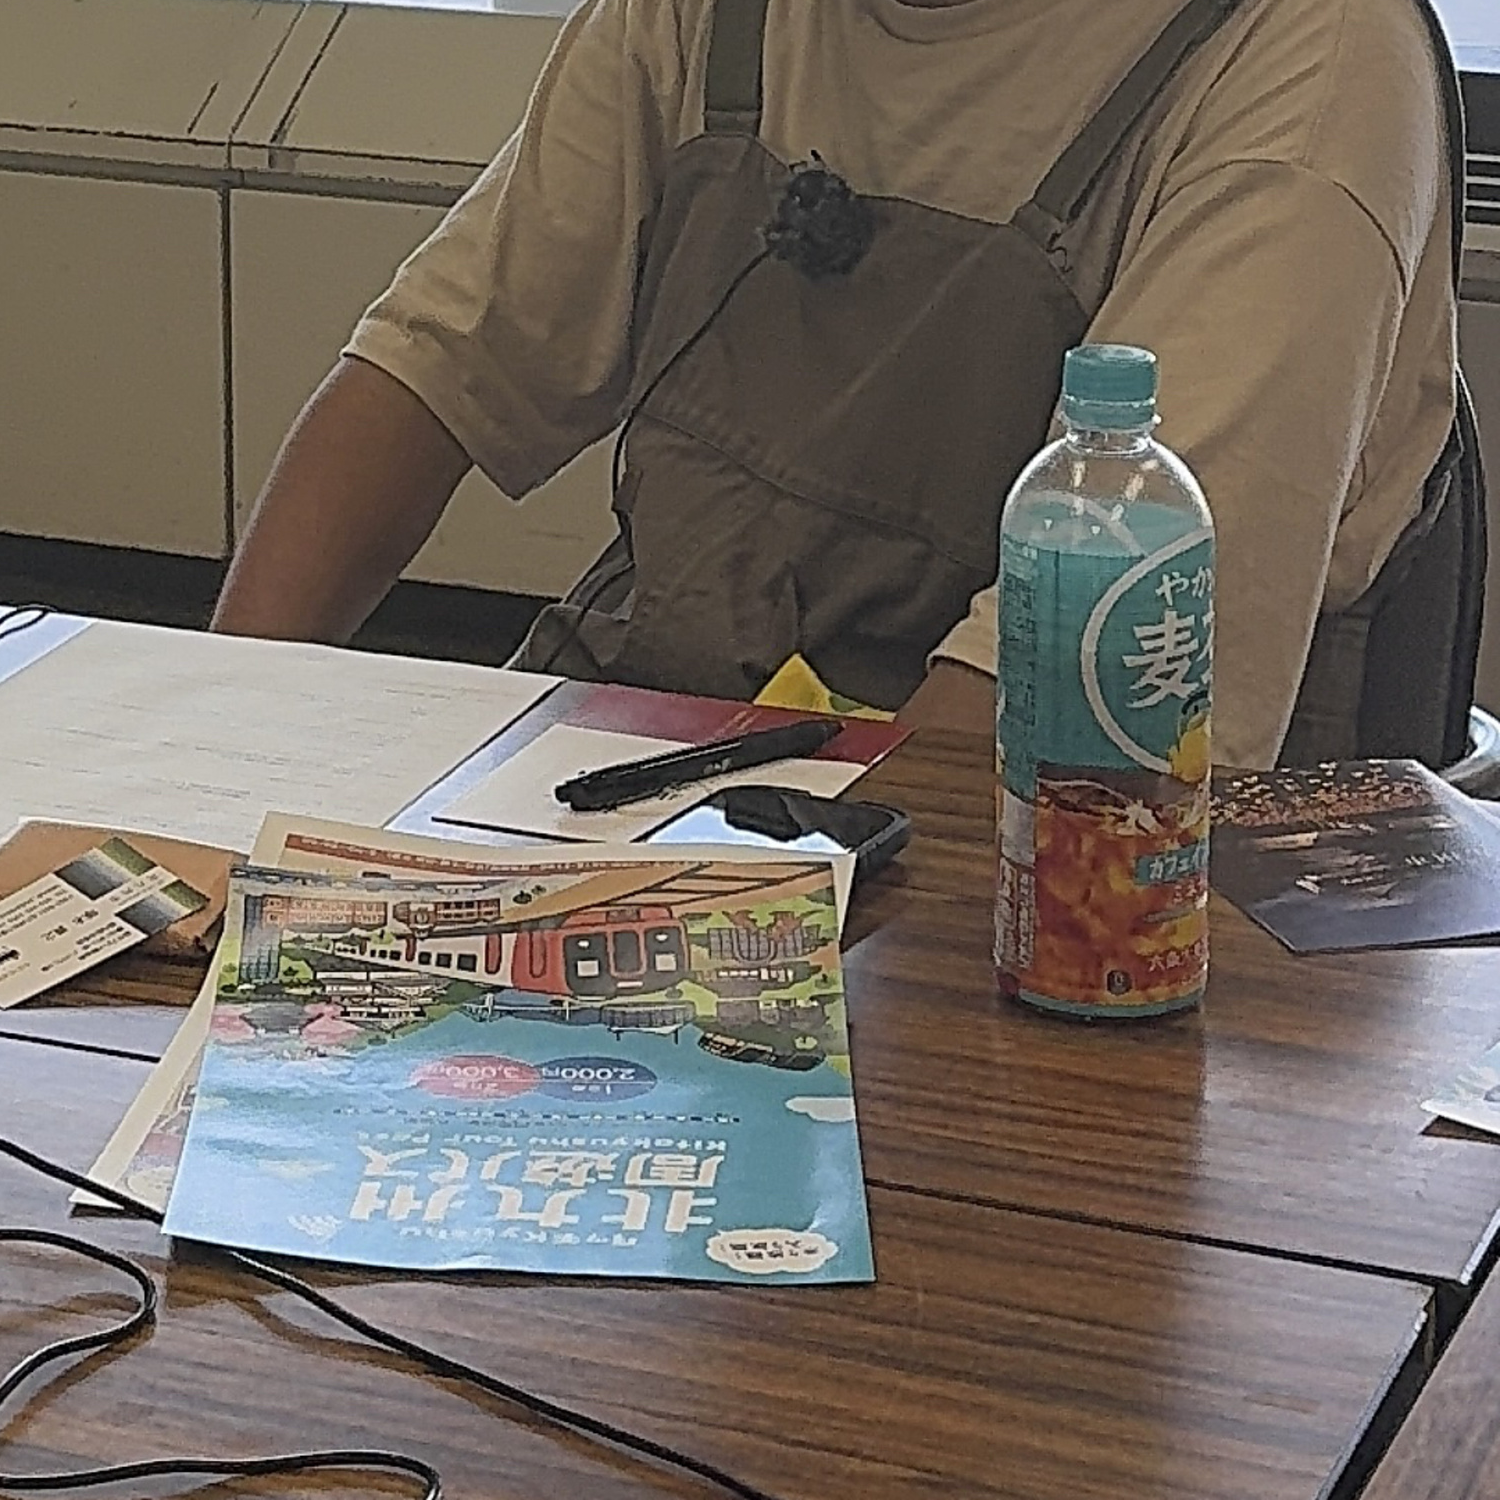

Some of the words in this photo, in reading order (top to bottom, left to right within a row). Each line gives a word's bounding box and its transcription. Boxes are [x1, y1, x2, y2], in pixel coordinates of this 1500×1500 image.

[1121, 607, 1213, 710] 麦
[357, 1145, 726, 1188] 周遊パス
[349, 1181, 719, 1233] 北九州
